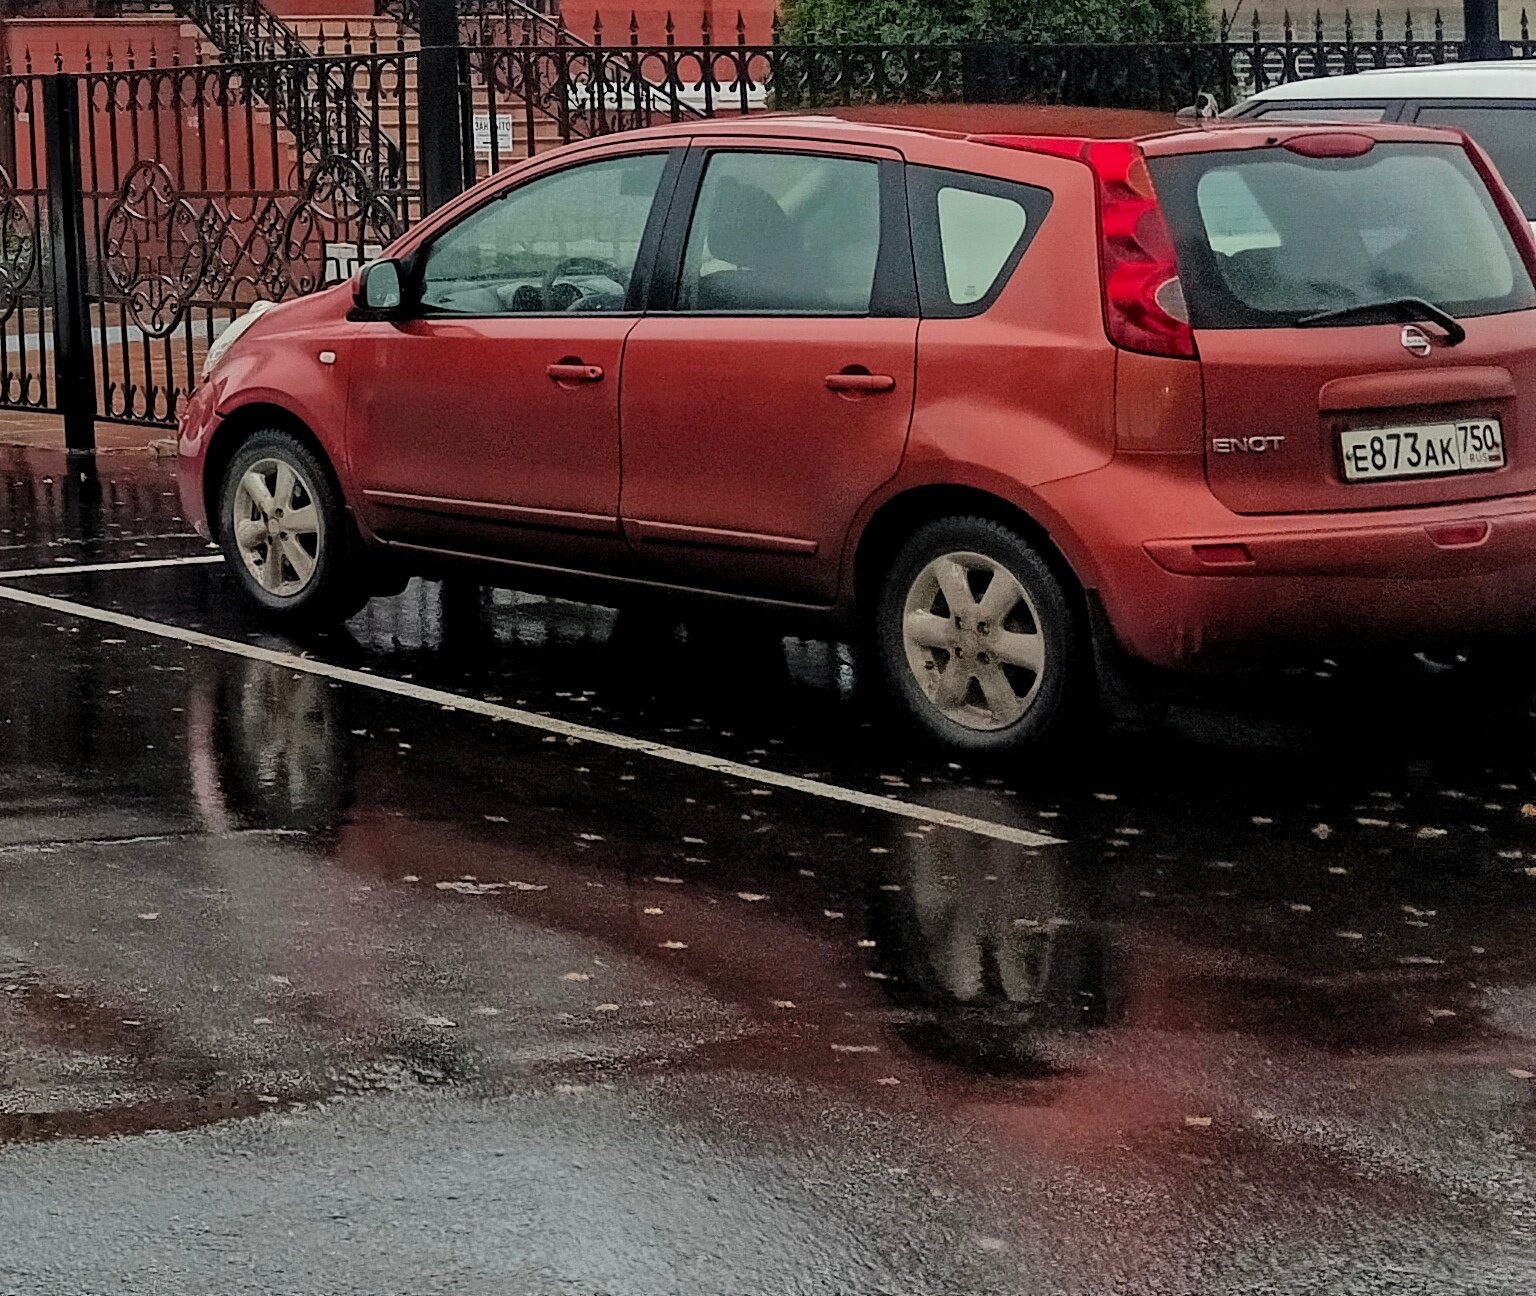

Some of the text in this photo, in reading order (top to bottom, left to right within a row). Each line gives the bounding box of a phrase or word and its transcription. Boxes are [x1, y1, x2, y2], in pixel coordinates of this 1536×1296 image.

[1352, 424, 1498, 472] Е873АК 750
[1469, 453, 1488, 462] RUS
